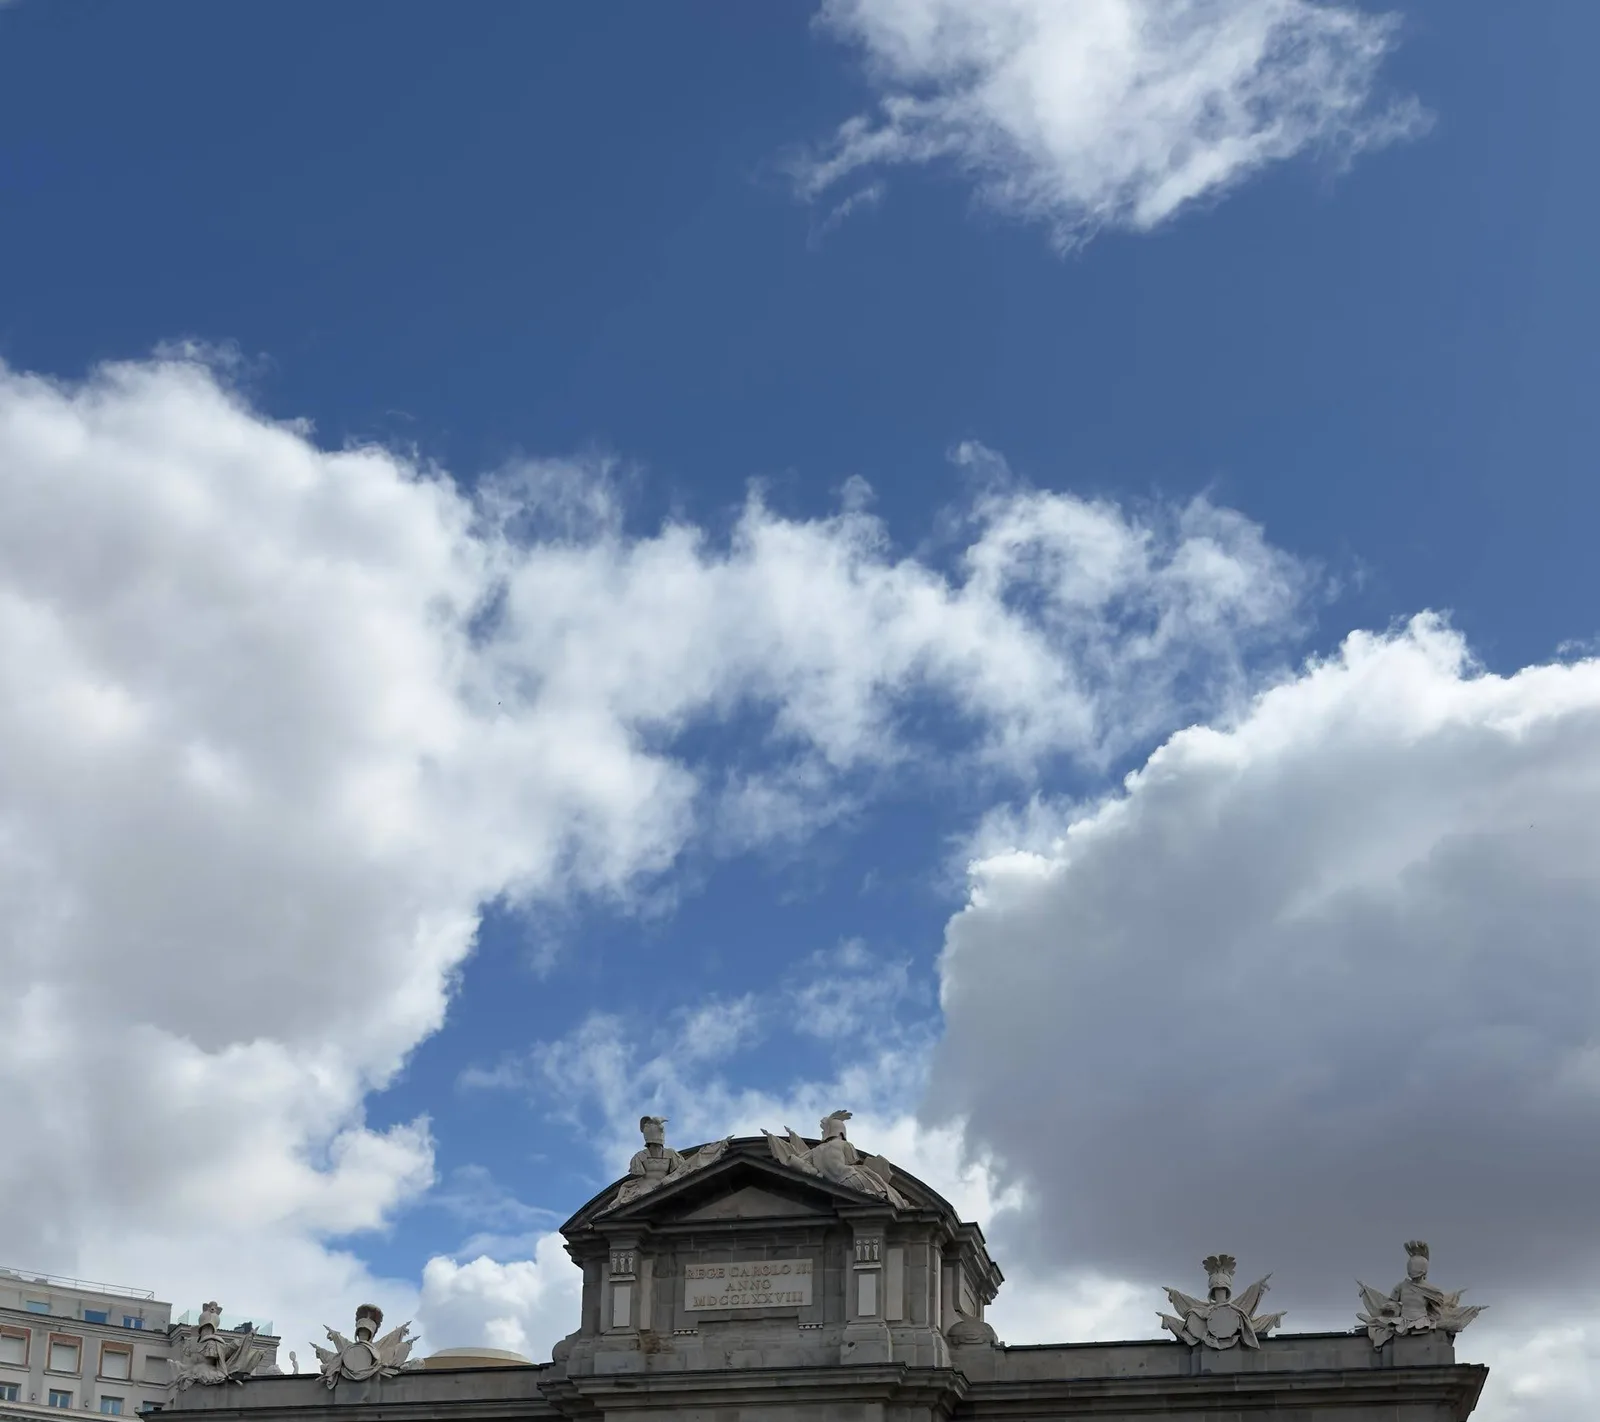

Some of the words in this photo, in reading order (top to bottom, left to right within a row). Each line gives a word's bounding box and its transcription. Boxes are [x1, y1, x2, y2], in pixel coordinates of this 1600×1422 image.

[729, 1265, 792, 1278] CAROLO
[725, 1279, 772, 1292] ANNO
[693, 1291, 803, 1307] MDCCLXXVIII
